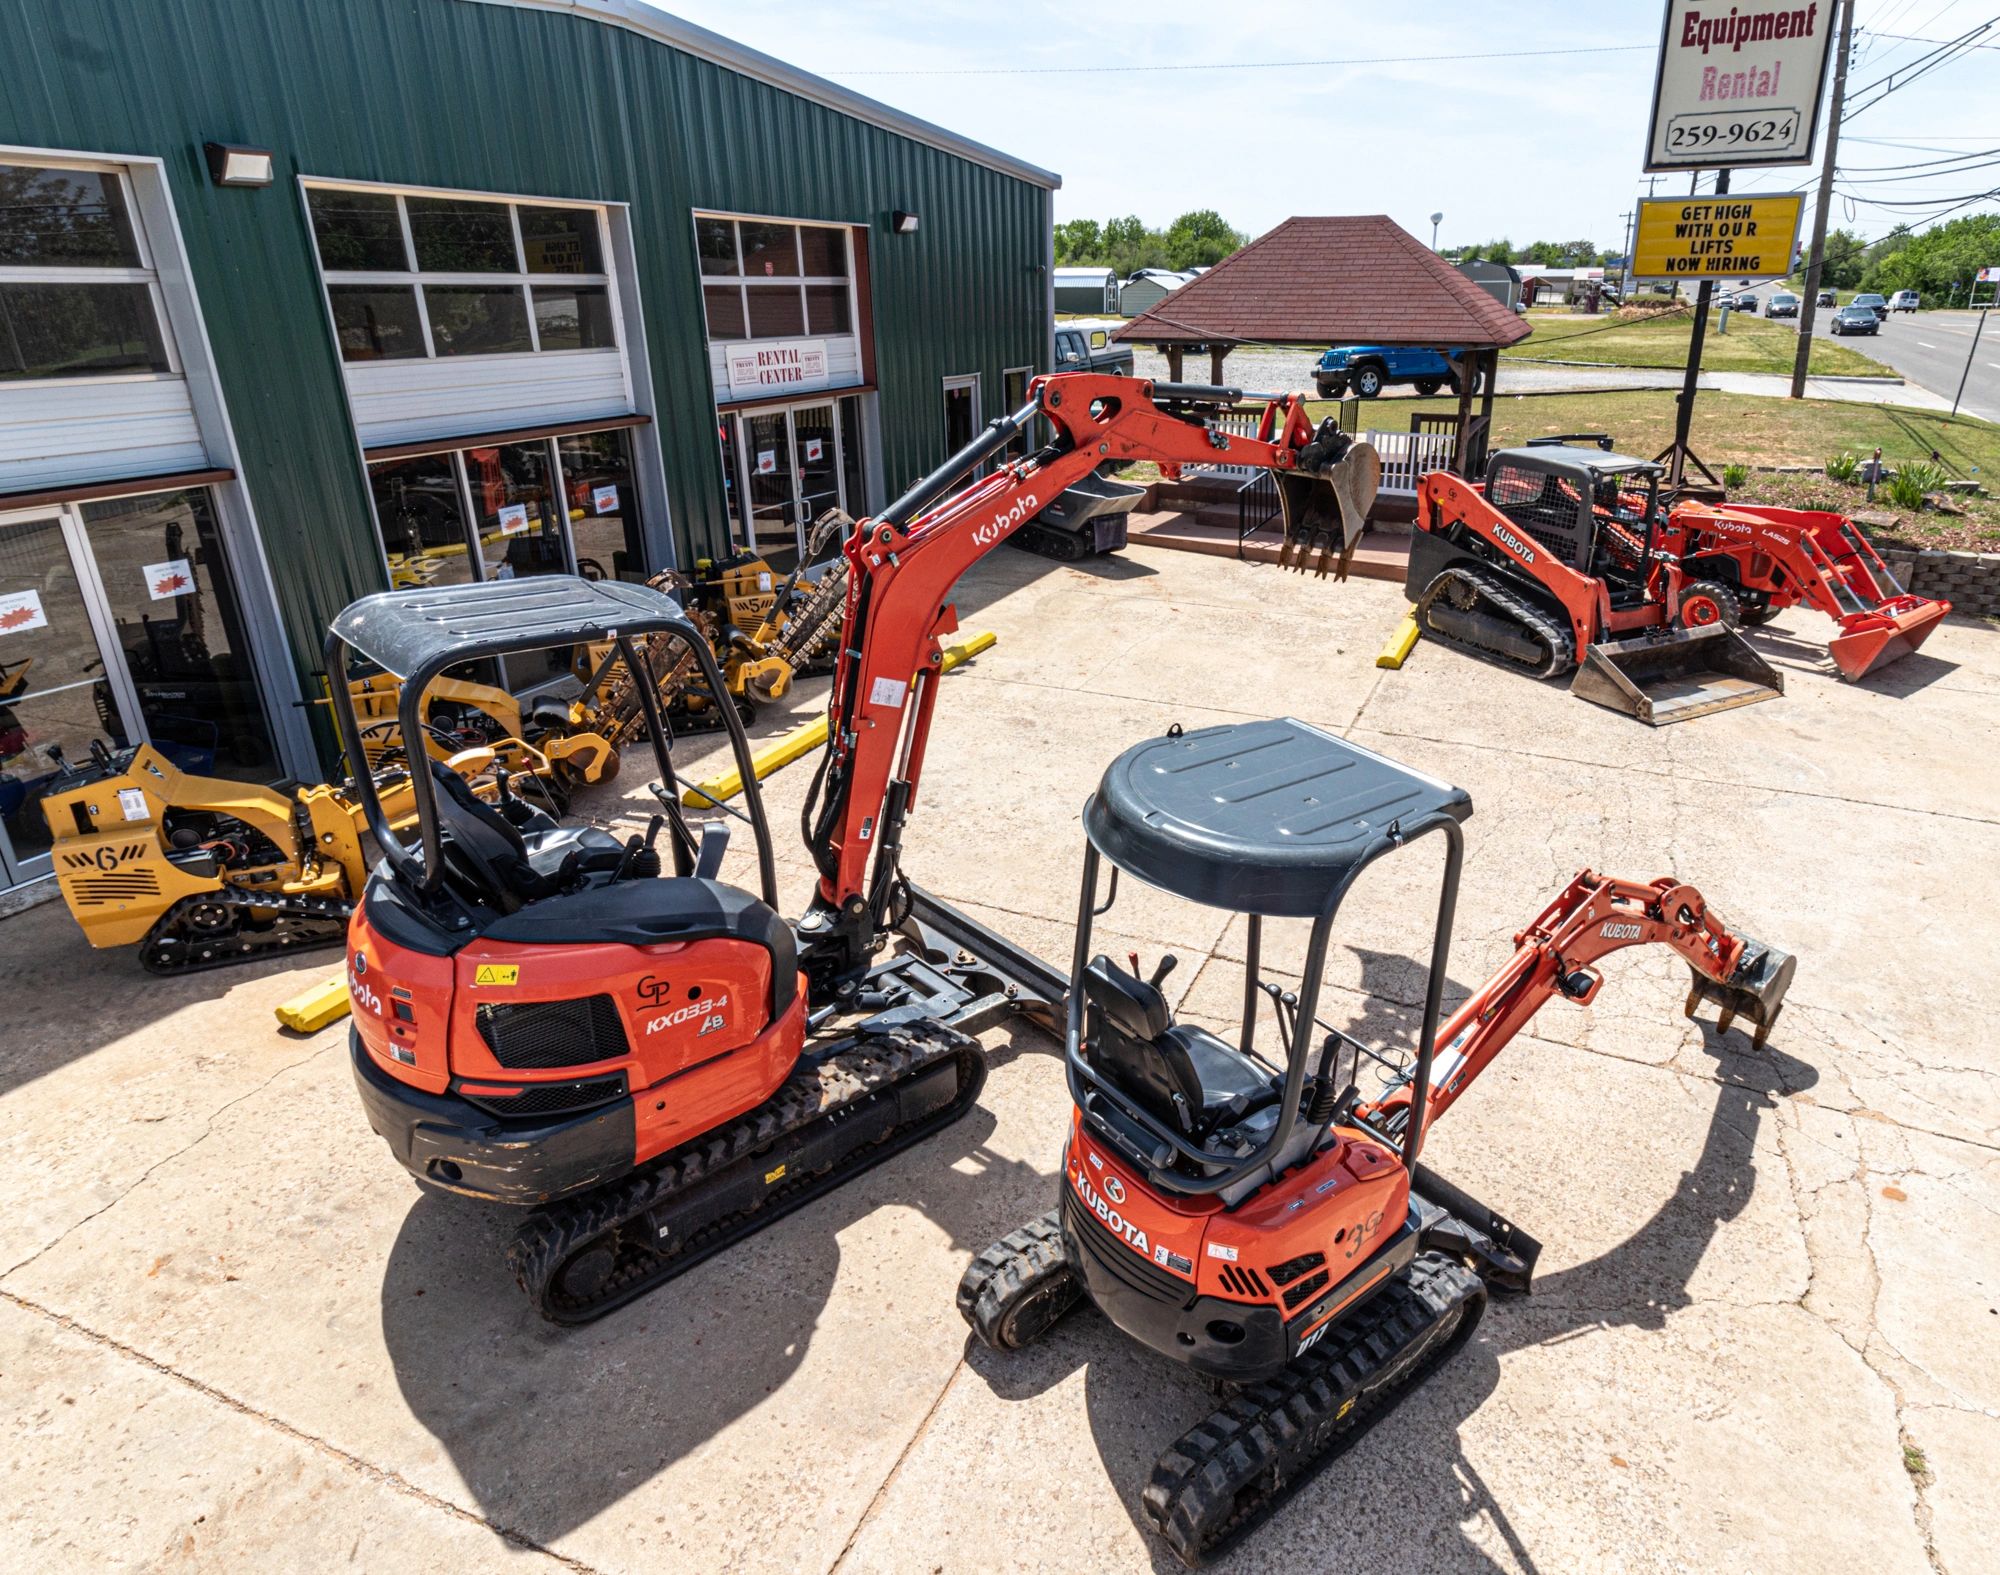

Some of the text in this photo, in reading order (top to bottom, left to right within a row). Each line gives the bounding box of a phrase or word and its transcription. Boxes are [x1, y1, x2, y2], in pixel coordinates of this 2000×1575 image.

[1681, 2, 1817, 54] Equipment
[1700, 61, 1781, 101] Rental
[1671, 118, 1793, 147] 259-9624
[1681, 205, 1752, 221] GET HIGH
[1676, 224, 1713, 238] WITH
[1690, 240, 1734, 254] LIFTS
[1666, 256, 1760, 272] NOW HIRING
[757, 348, 801, 367] RENTAL
[760, 367, 802, 385] CENTER
[972, 494, 1038, 547] Kubota
[1714, 519, 1752, 535] Kubota
[1492, 523, 1535, 564] KUBOTA
[749, 598, 760, 613] 5
[96, 846, 118, 871] 6
[1600, 922, 1642, 940] KUBOTA
[349, 969, 382, 1016] bota
[646, 994, 728, 1035] KX033-4
[1077, 1170, 1150, 1255] KUBOTA
